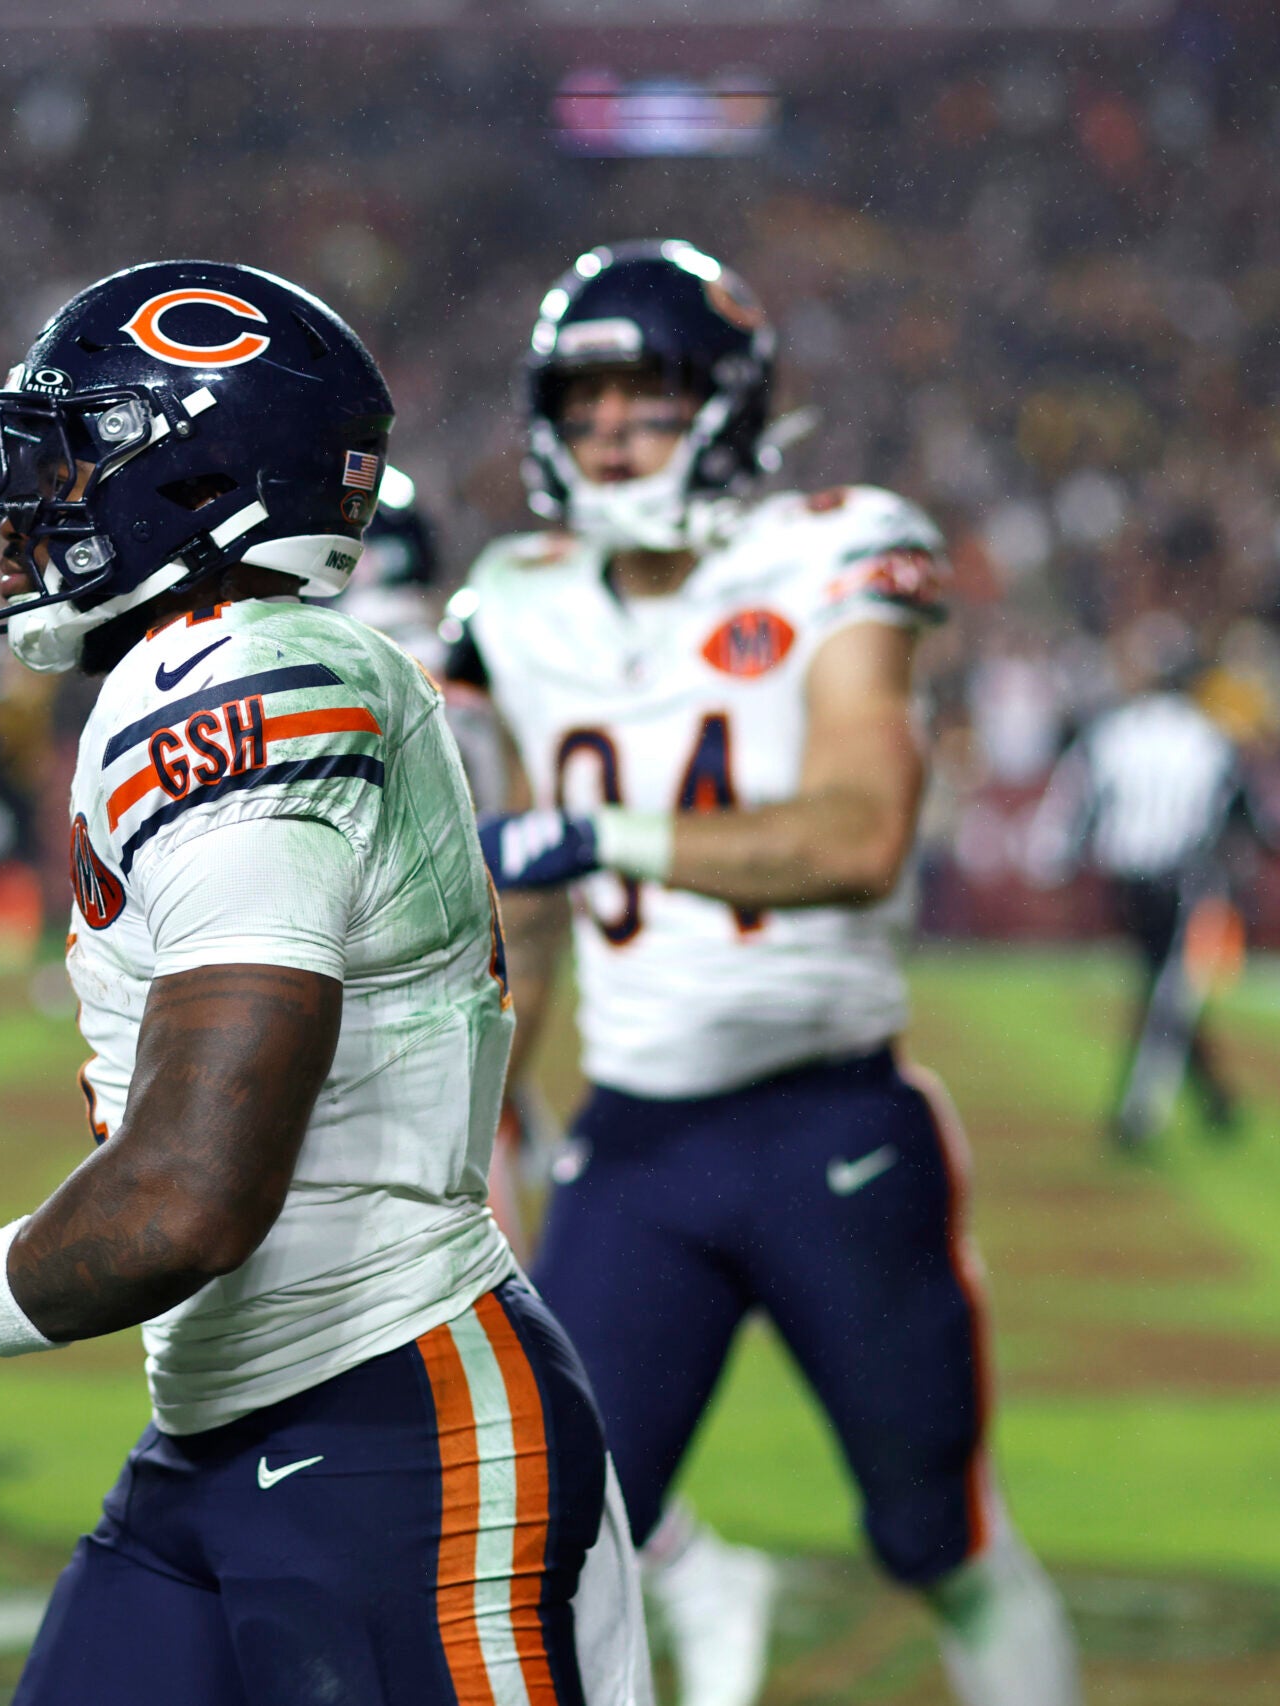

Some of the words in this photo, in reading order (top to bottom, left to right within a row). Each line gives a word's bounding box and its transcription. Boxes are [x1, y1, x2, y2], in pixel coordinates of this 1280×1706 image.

[120, 288, 270, 368] C
[26, 383, 70, 396] OAKLEY
[325, 550, 358, 575] INSP
[150, 693, 268, 801] GSH
